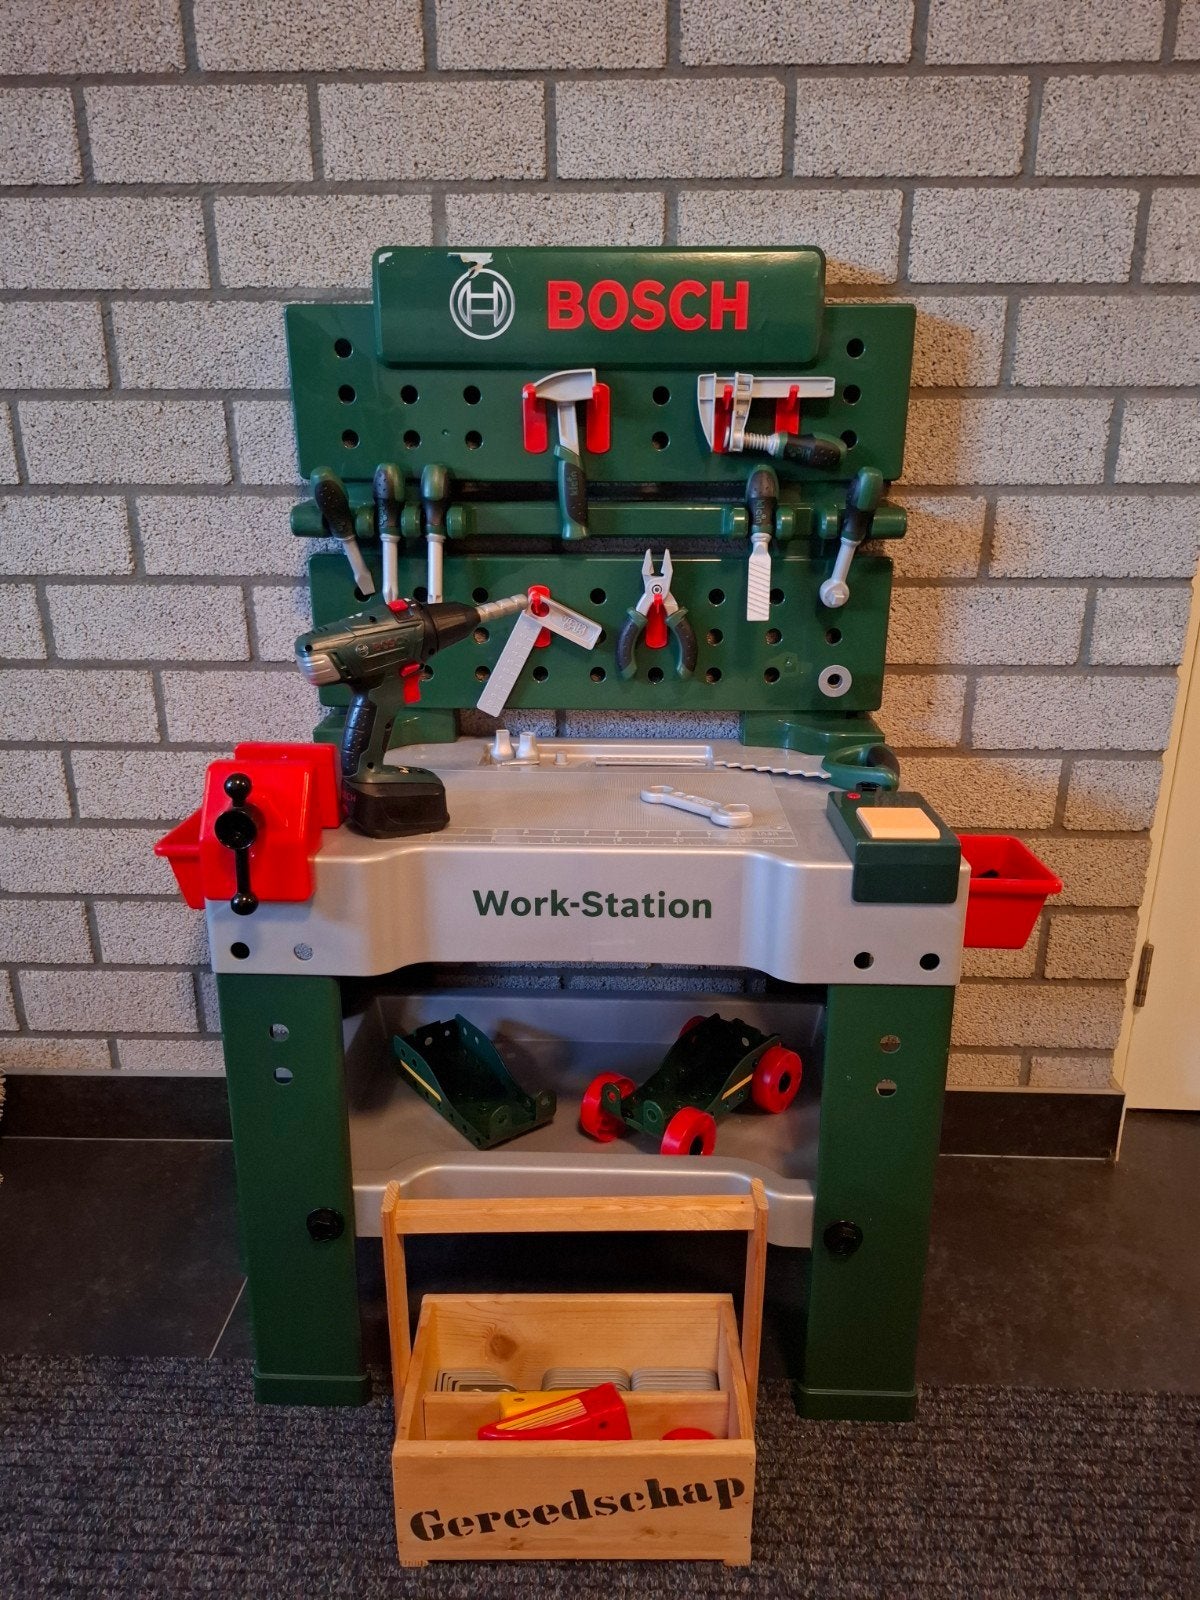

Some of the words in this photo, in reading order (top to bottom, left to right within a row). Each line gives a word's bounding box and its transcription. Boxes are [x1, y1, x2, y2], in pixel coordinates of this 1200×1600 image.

[547, 279, 750, 332] BOSCH
[472, 889, 712, 919] Work-Station
[410, 1478, 745, 1542] Gereedschap
